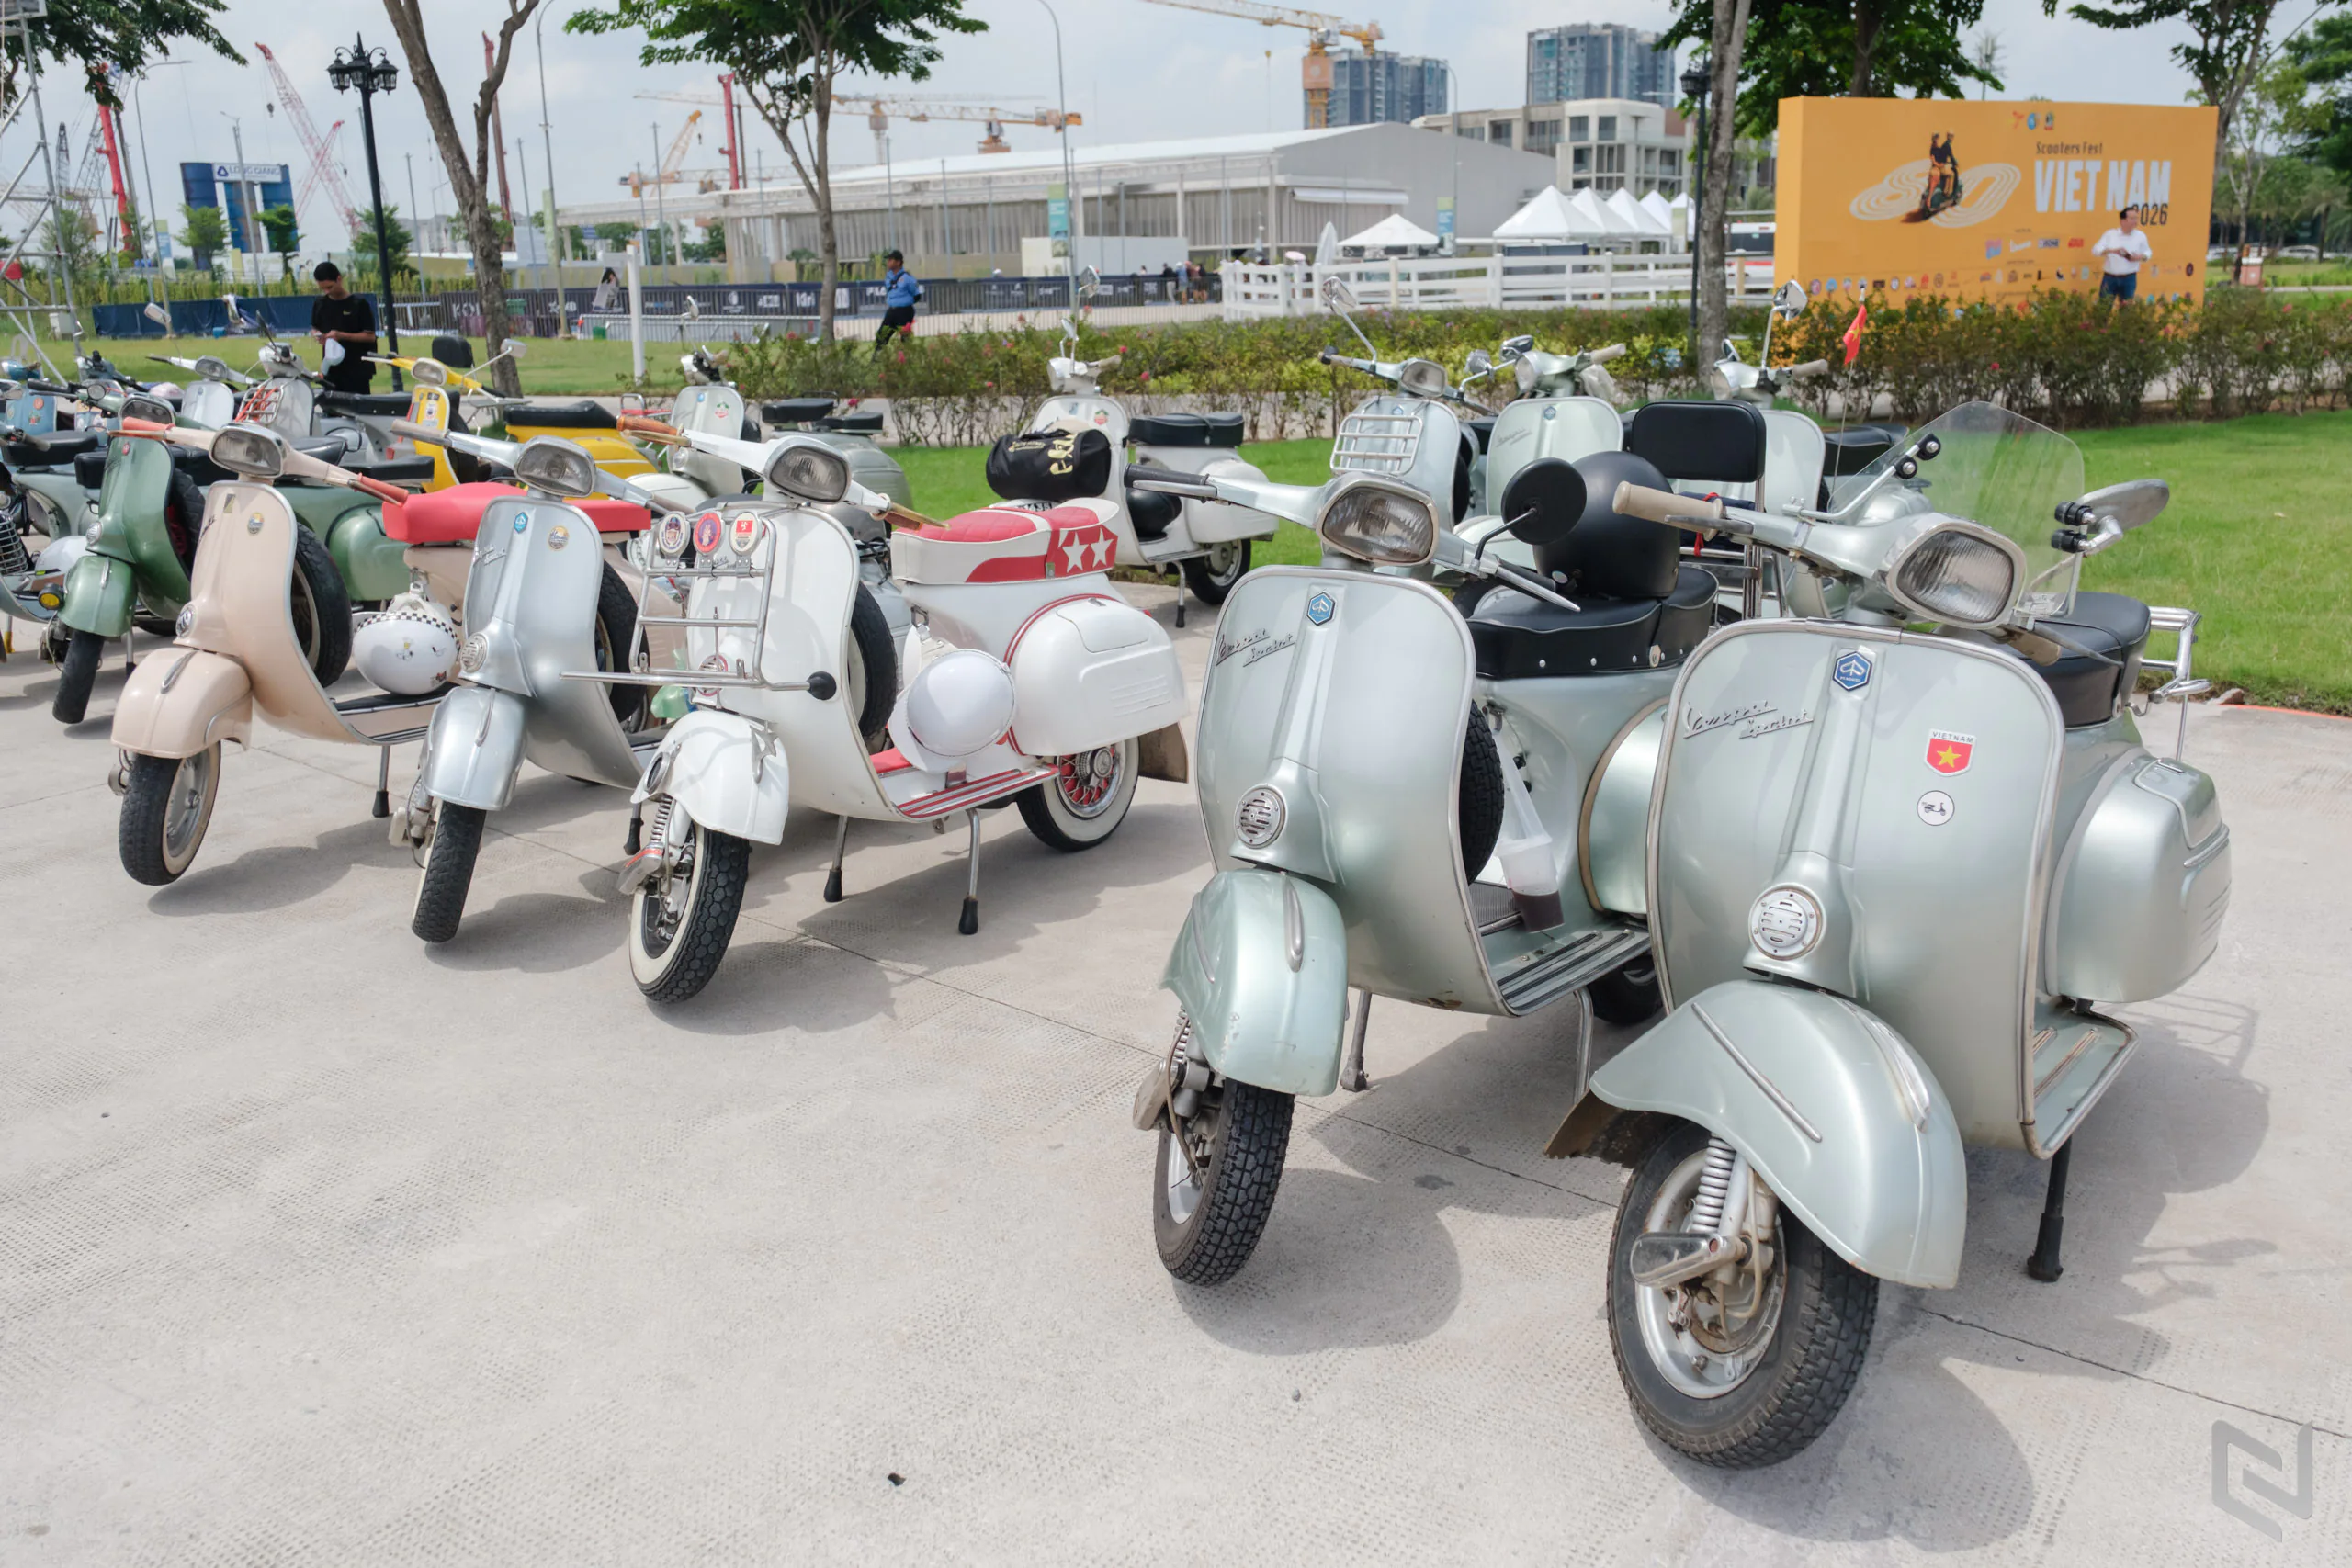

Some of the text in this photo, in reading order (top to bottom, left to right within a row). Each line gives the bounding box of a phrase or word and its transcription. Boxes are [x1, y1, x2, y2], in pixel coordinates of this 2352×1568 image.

[2036, 141, 2103, 154] Scooters Fest
[2034, 159, 2172, 213] VIET NAM
[1932, 731, 1973, 743] VIETNAM
